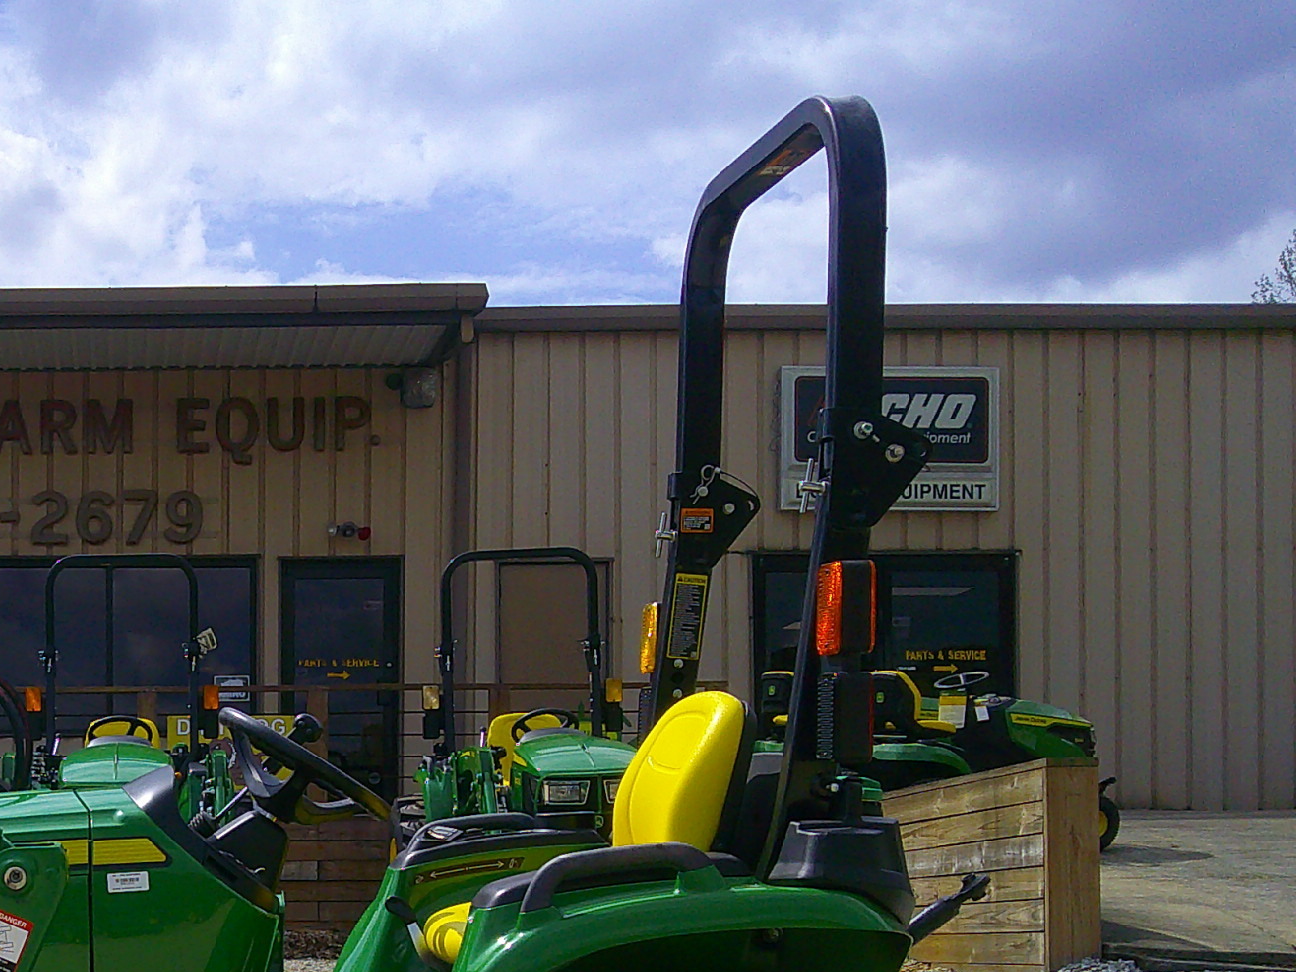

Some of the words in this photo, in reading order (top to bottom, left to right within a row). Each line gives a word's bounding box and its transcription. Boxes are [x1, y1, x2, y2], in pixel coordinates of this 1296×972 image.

[882, 393, 977, 429] CHO
[176, 396, 381, 466] EQUIP.
[903, 484, 986, 500] UIPMENT
[948, 650, 987, 661] SERVICE
